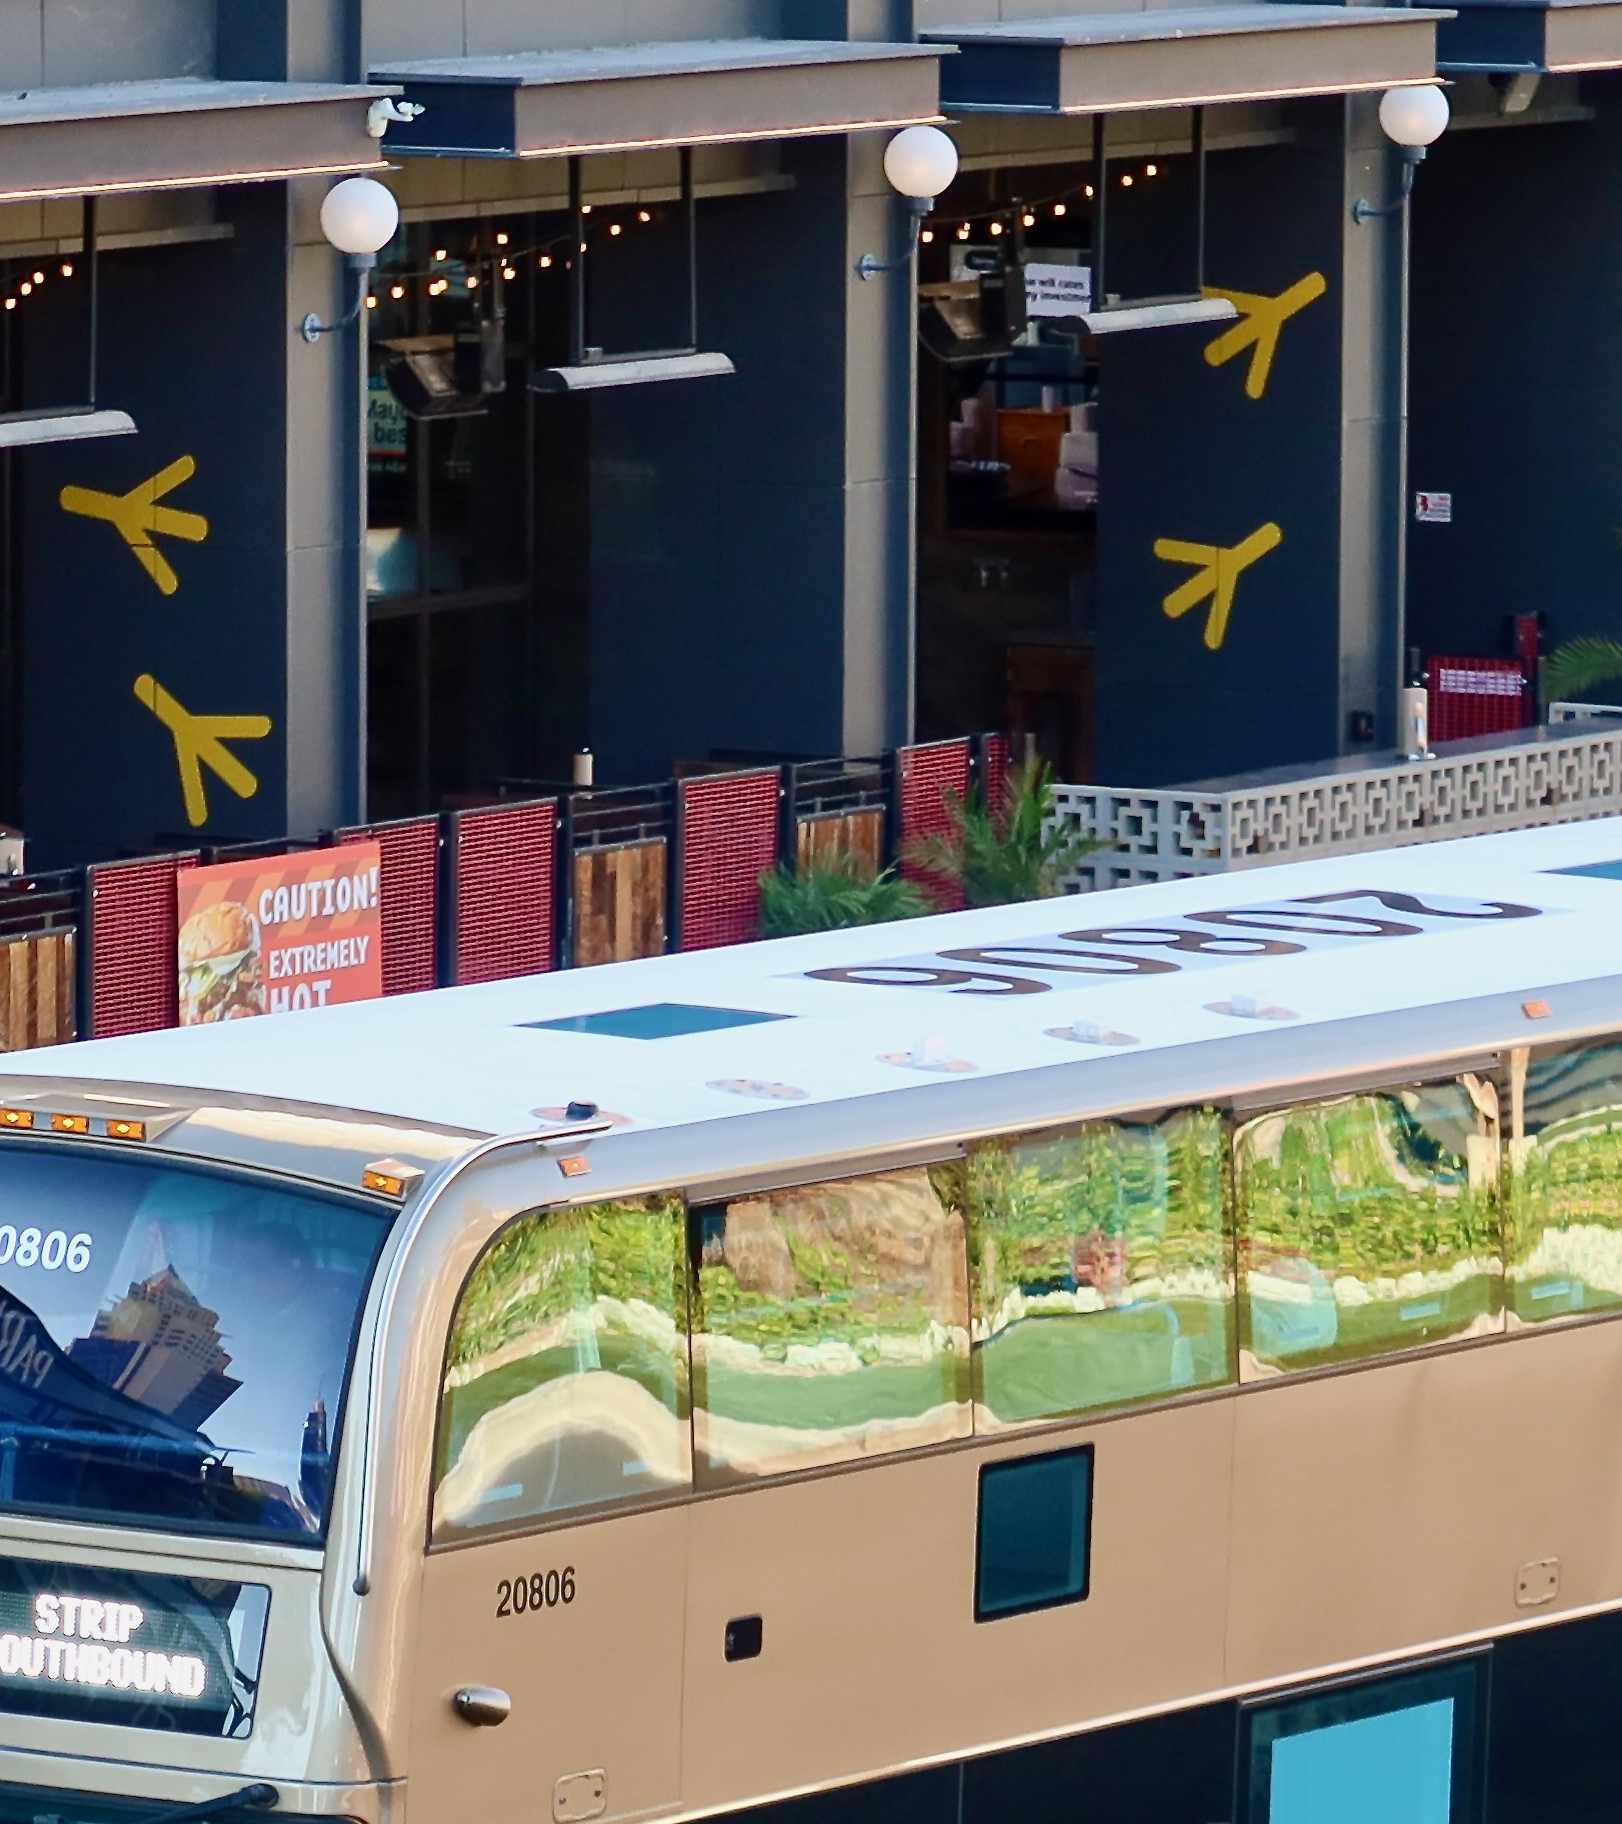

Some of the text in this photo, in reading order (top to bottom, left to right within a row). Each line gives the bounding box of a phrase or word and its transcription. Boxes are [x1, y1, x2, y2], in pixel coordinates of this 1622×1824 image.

[258, 866, 379, 926] CAUTION!
[269, 935, 370, 980] EXTREMELY
[803, 889, 1543, 995] 20806
[270, 979, 332, 1014] HOT
[34, 1593, 145, 1643] STRIP
[496, 1566, 576, 1619] 20806
